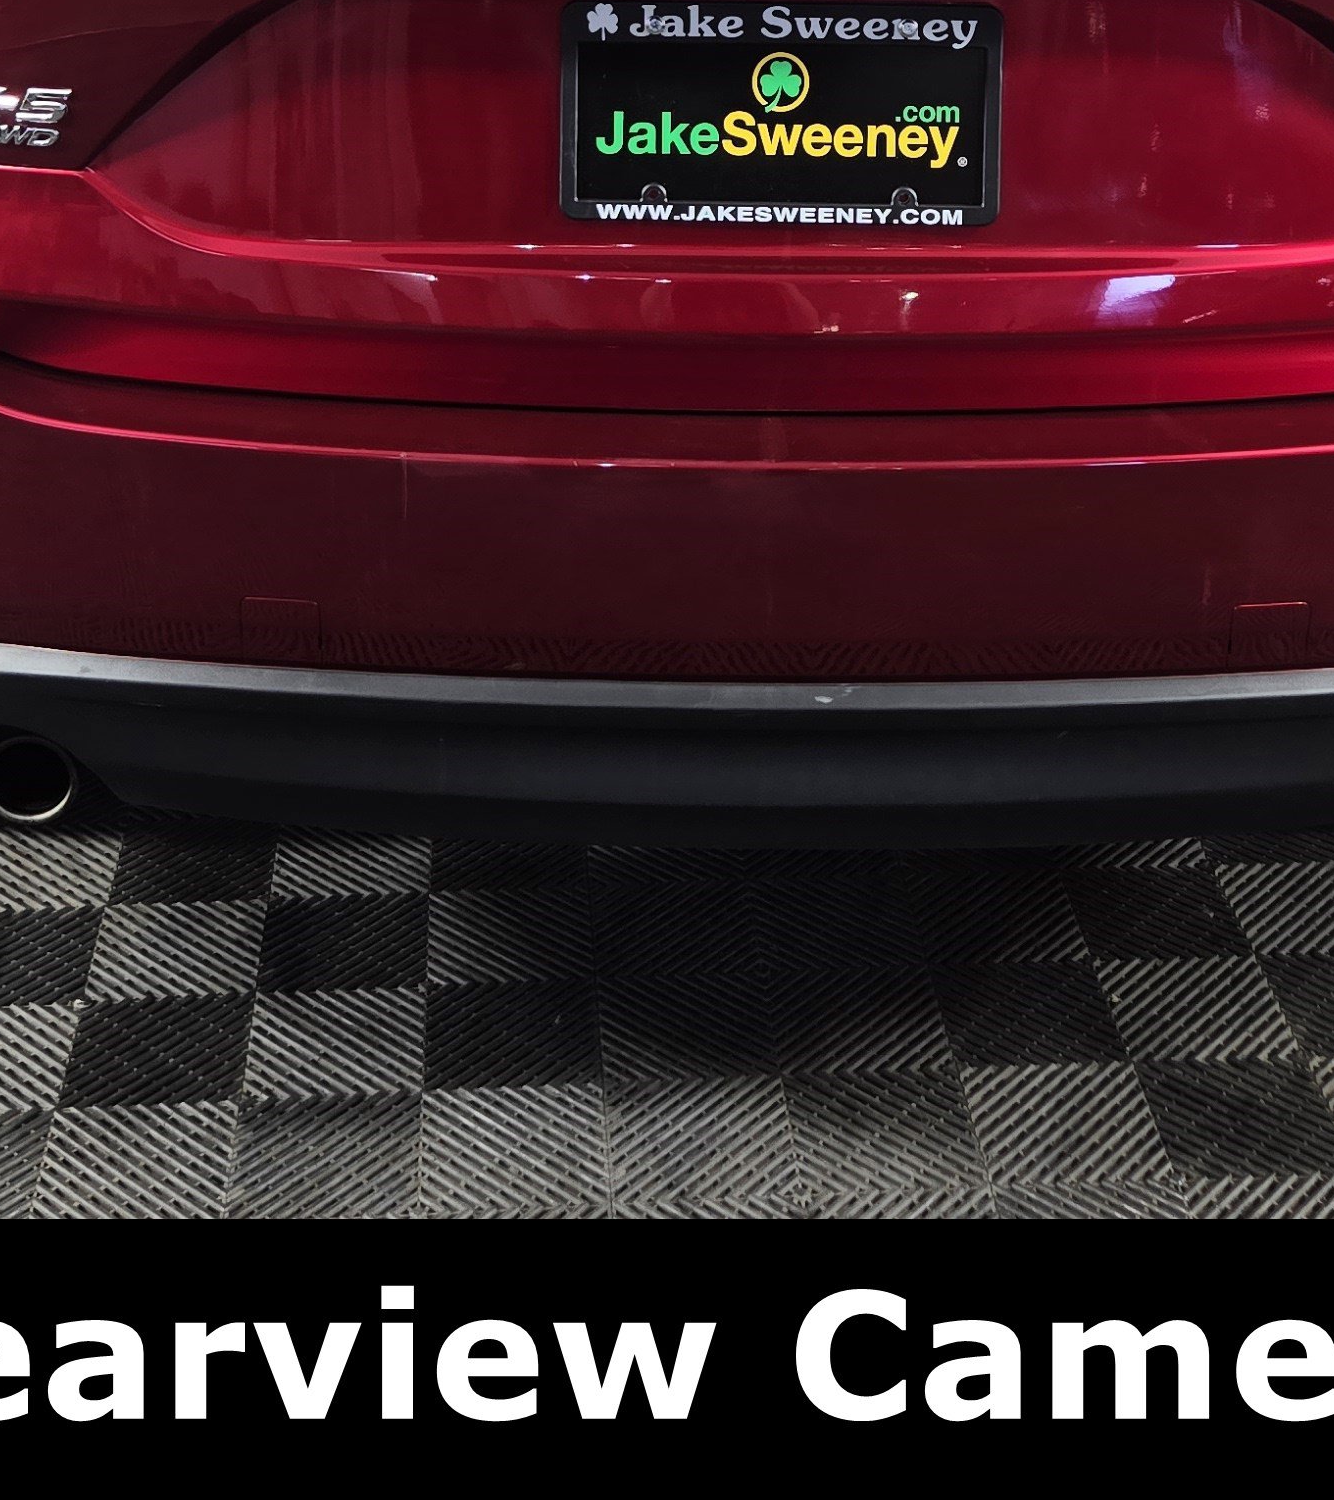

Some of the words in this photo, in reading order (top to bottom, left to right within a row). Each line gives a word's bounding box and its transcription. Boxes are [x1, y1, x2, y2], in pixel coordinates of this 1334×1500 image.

[630, 4, 745, 39] Jake
[760, 5, 979, 50] Sweeney
[895, 105, 961, 124] .com
[596, 203, 964, 226] WWW.JAKESWEENEY.COM
